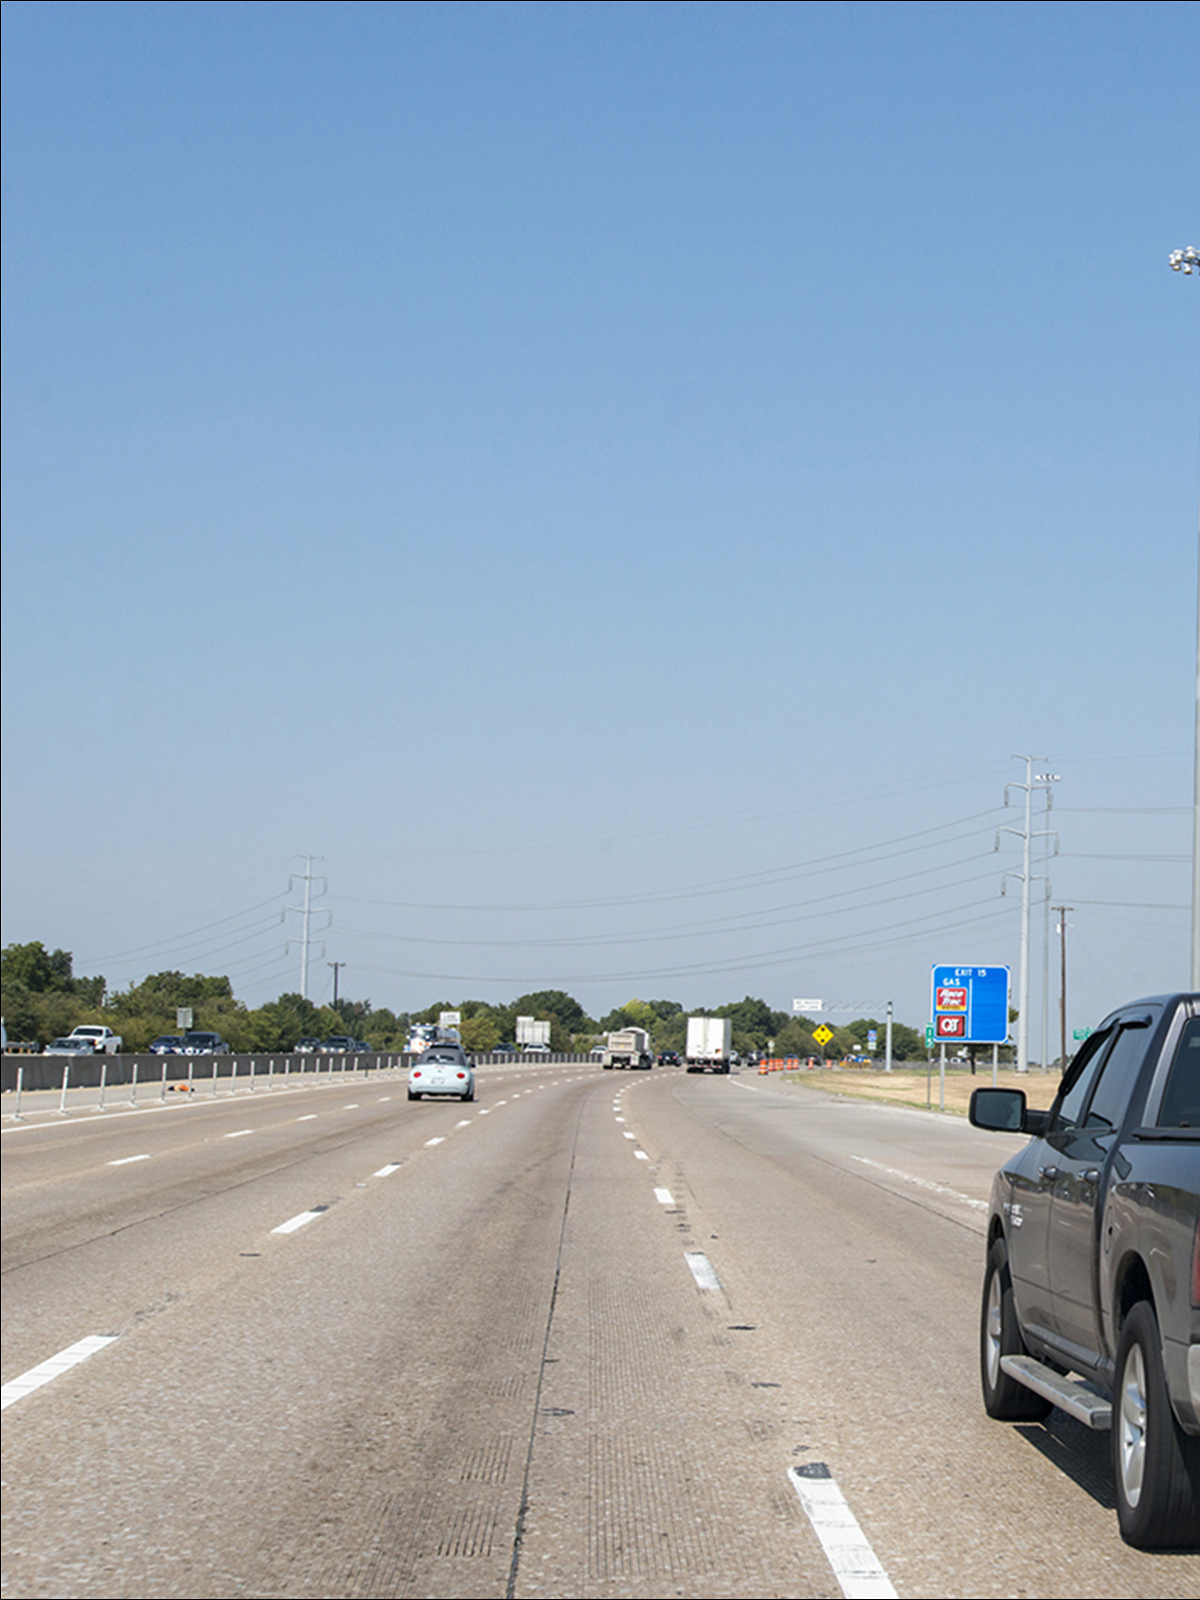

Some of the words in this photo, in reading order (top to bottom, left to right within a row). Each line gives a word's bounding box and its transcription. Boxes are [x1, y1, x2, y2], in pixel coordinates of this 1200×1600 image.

[955, 968, 972, 976] EXIT
[943, 978, 960, 986] GAS
[941, 1018, 960, 1033] QT
